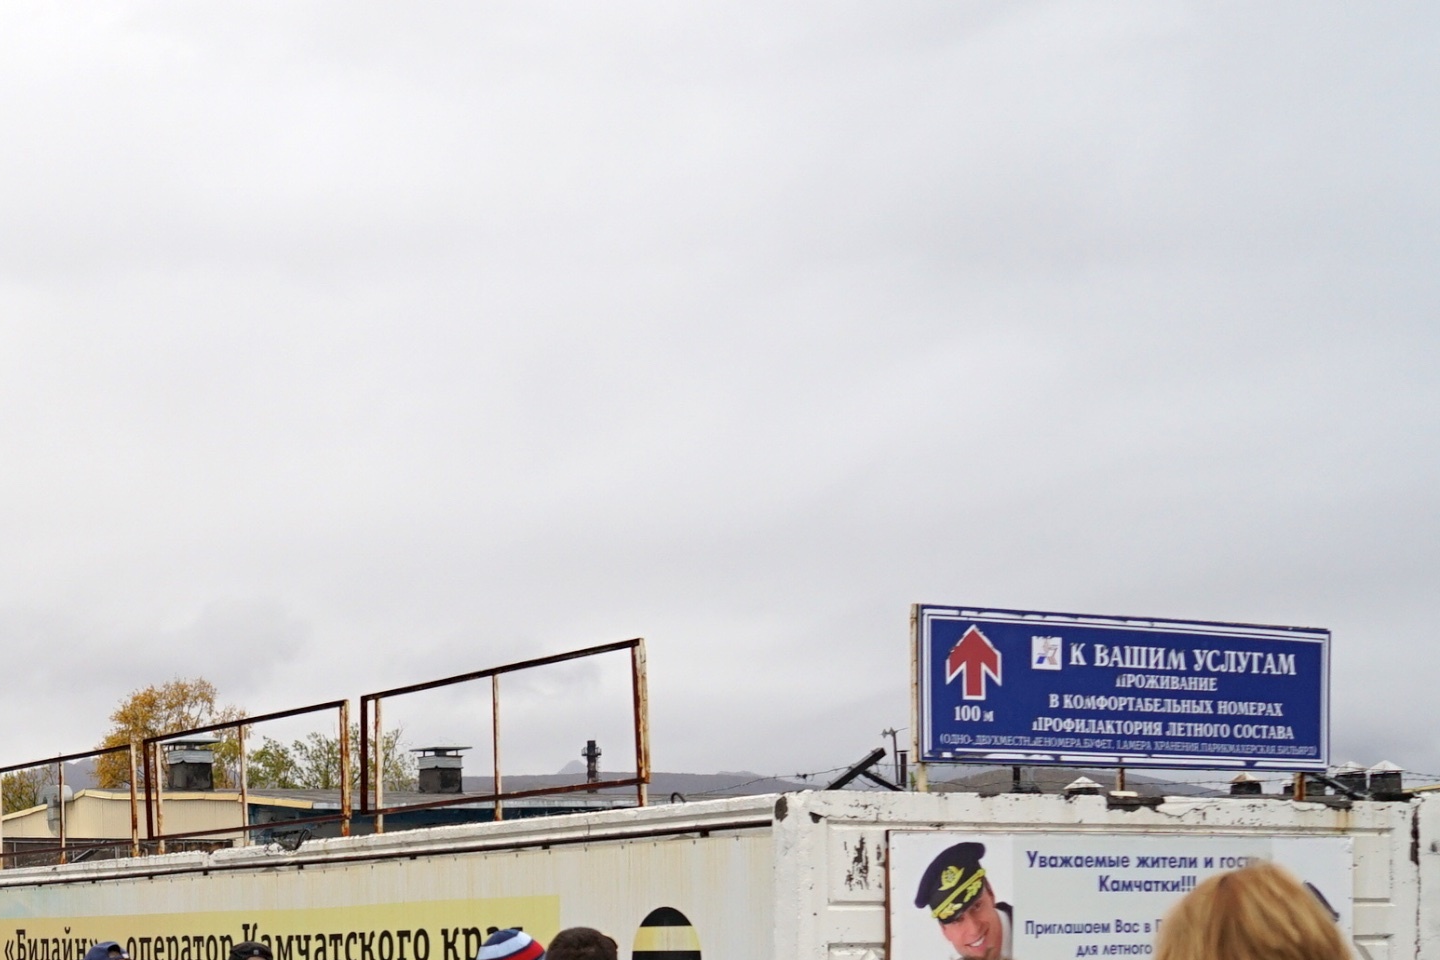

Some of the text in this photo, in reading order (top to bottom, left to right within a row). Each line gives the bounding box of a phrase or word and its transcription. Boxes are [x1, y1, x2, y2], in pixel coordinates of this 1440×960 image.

[1070, 643, 1297, 676] К ВАШИМ УСЛУГАМ
[954, 705, 981, 722] 100
[1049, 693, 1283, 717] В КОМФОРТАБЕЛЬНЫХ НОМЕРАХ
[1165, 721, 1230, 738] ЛЕТНОГО
[1233, 724, 1295, 740] СОСТАВА
[1026, 851, 1130, 869] Уважаемые
[1136, 856, 1198, 869] жители
[1204, 856, 1214, 869] и
[1098, 875, 1197, 892] Камчатки!!!
[1025, 920, 1111, 938] Приглашаем
[1115, 919, 1140, 933] Вас
[1144, 923, 1151, 933] в
[1076, 942, 1153, 957] для летного
